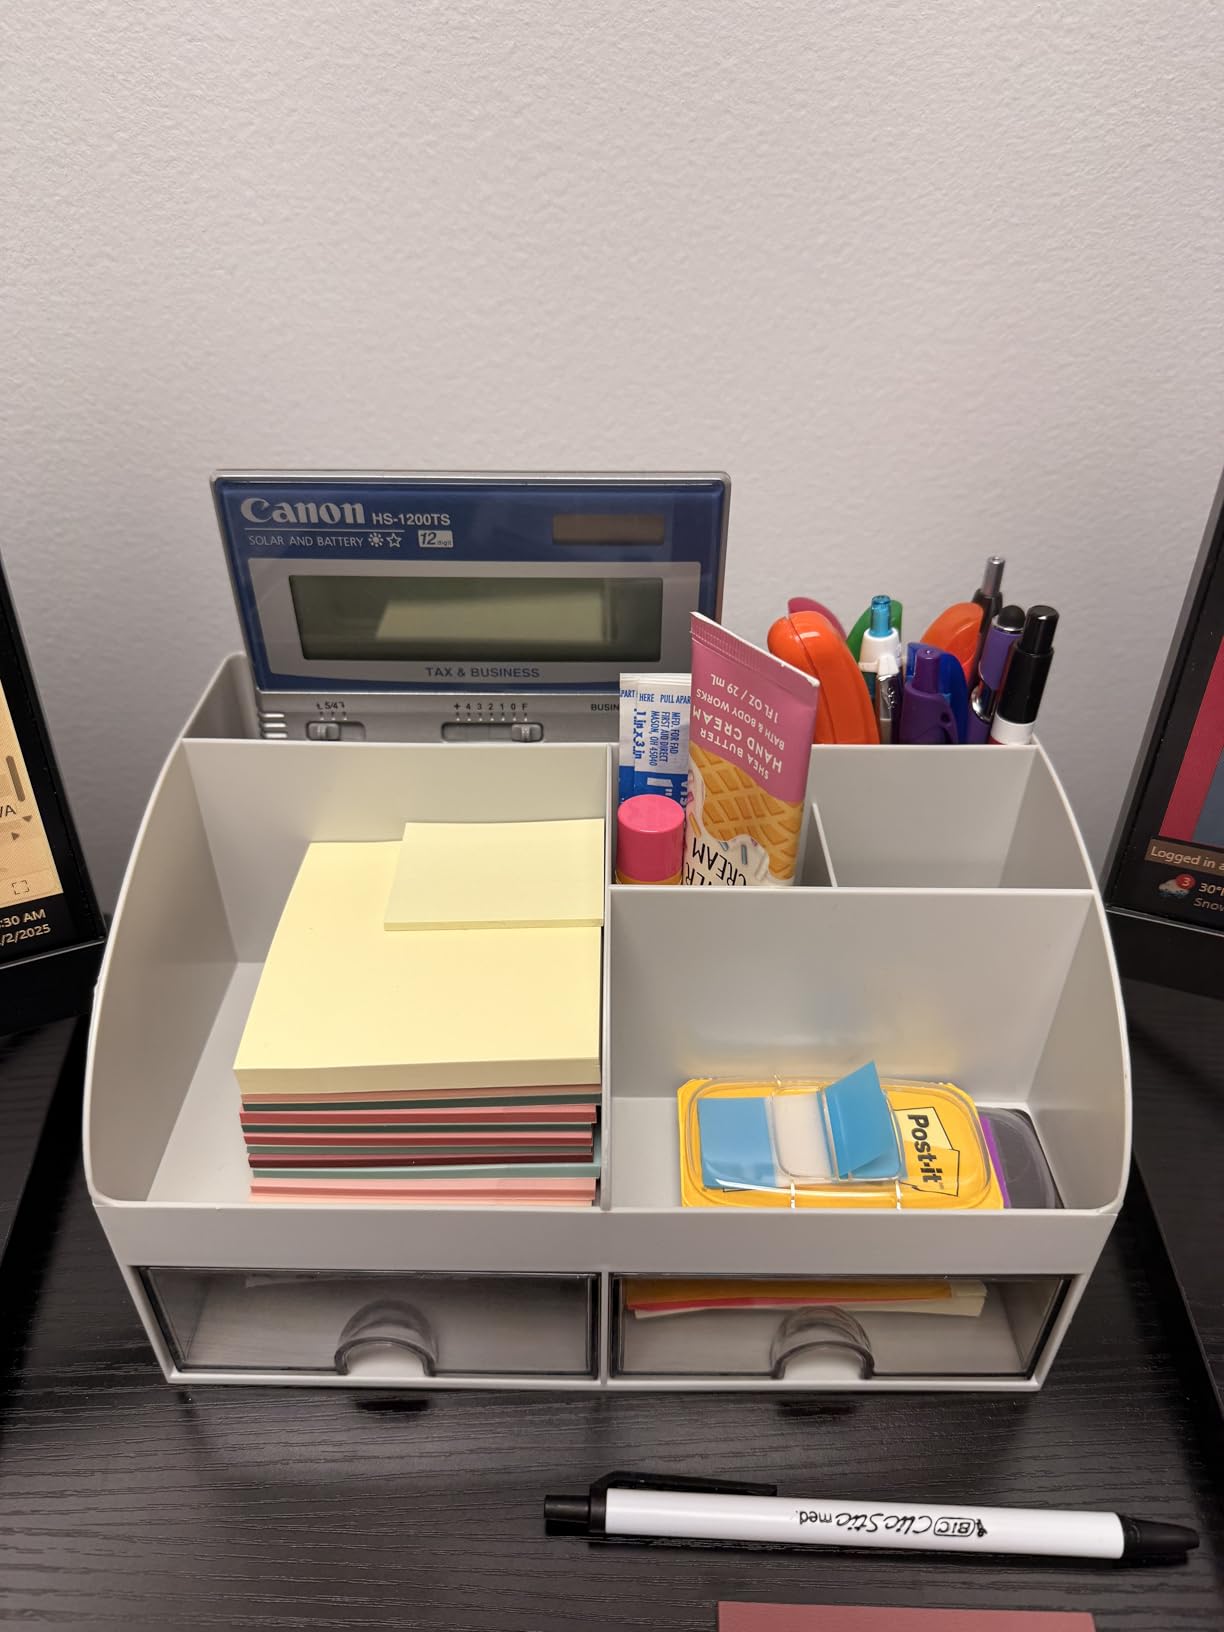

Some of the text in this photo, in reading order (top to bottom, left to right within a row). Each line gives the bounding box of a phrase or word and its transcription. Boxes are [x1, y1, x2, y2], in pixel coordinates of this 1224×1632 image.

[241, 498, 365, 524] Canon
[372, 513, 450, 526] HS-1200TS
[249, 534, 364, 548] SOLAR AND BATTERY
[420, 531, 437, 545] 12
[426, 667, 540, 679] TAX & BUSINESS
[710, 673, 725, 688] mL
[619, 689, 635, 698] PART
[727, 683, 739, 697] 29
[640, 693, 655, 703] HERE
[660, 694, 675, 704] PULL
[696, 688, 730, 713] WORKS
[749, 694, 763, 711] OZ
[731, 707, 756, 728] BODY
[764, 704, 774, 720] FL
[650, 710, 660, 735] MASON,
[659, 711, 671, 762] FIRST AID DIRECT
[670, 729, 680, 741] FOR
[692, 705, 782, 774] HAND CREAM
[764, 728, 785, 751] BATH
[669, 742, 679, 755] FAD
[700, 727, 769, 780] SHEA BUTTER
[1150, 846, 1201, 865] Logged
[1203, 856, 1216, 868] in
[1181, 877, 1191, 887] 3
[0, 909, 46, 928] :30 AM
[0, 923, 51, 946] /2/2025
[908, 1114, 943, 1183] Post-it
[937, 1521, 971, 1535] BIC
